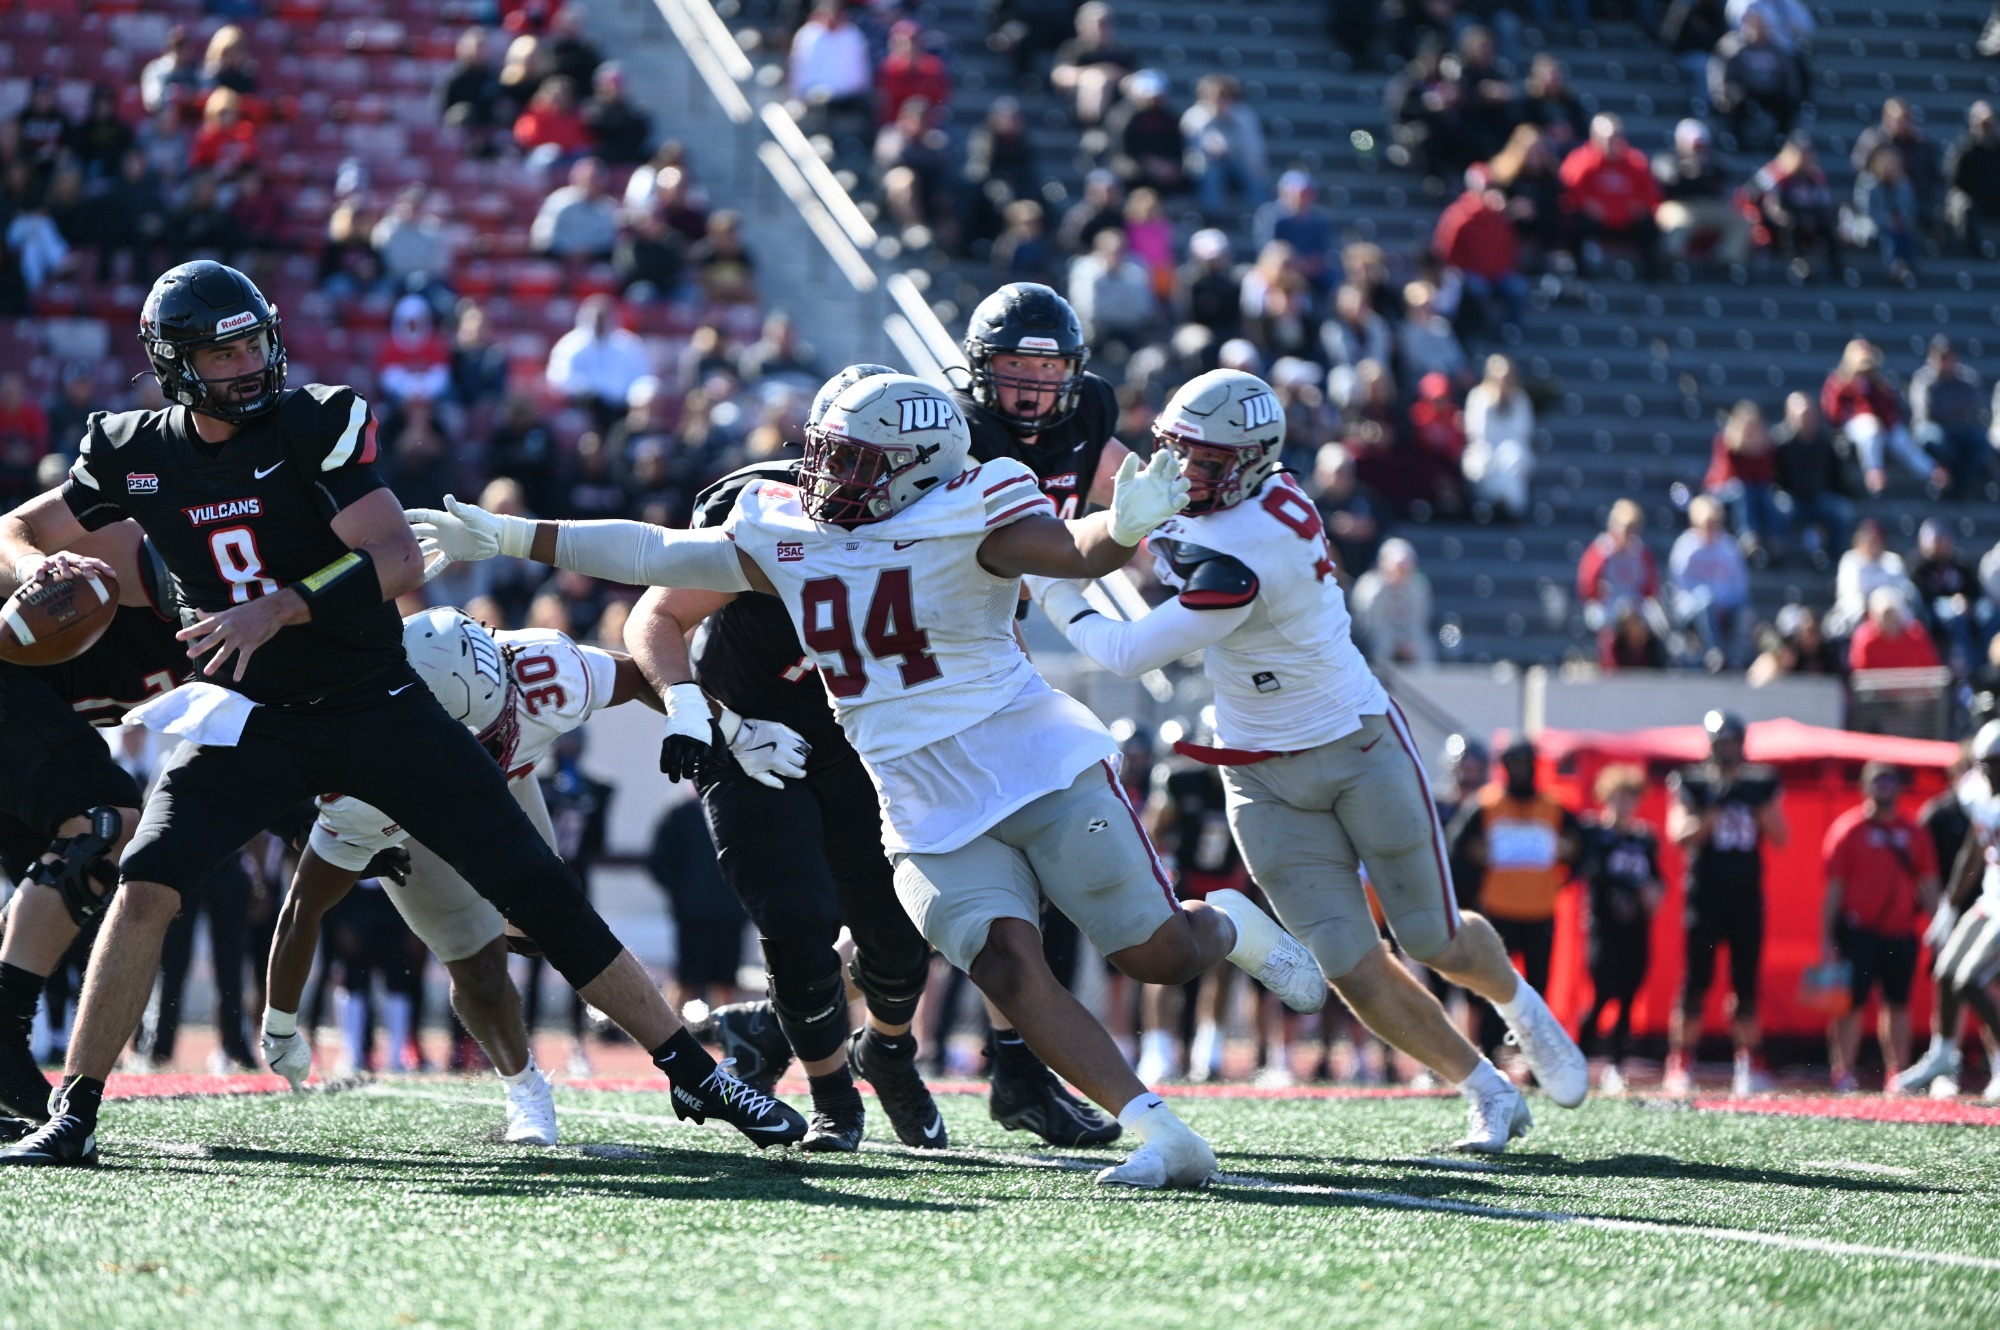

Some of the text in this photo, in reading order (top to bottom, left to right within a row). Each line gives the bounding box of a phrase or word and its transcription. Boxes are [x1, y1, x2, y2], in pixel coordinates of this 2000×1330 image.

[221, 313, 252, 330] Riddell
[901, 398, 953, 432] IUP
[128, 478, 157, 488] PSAC
[187, 498, 261, 525] VULCANS
[208, 525, 281, 604] 8
[777, 547, 805, 557] PSAC
[27, 580, 73, 606] Wilson
[800, 565, 943, 699] 94
[513, 655, 567, 717] 30
[673, 1084, 704, 1112] NIKE
